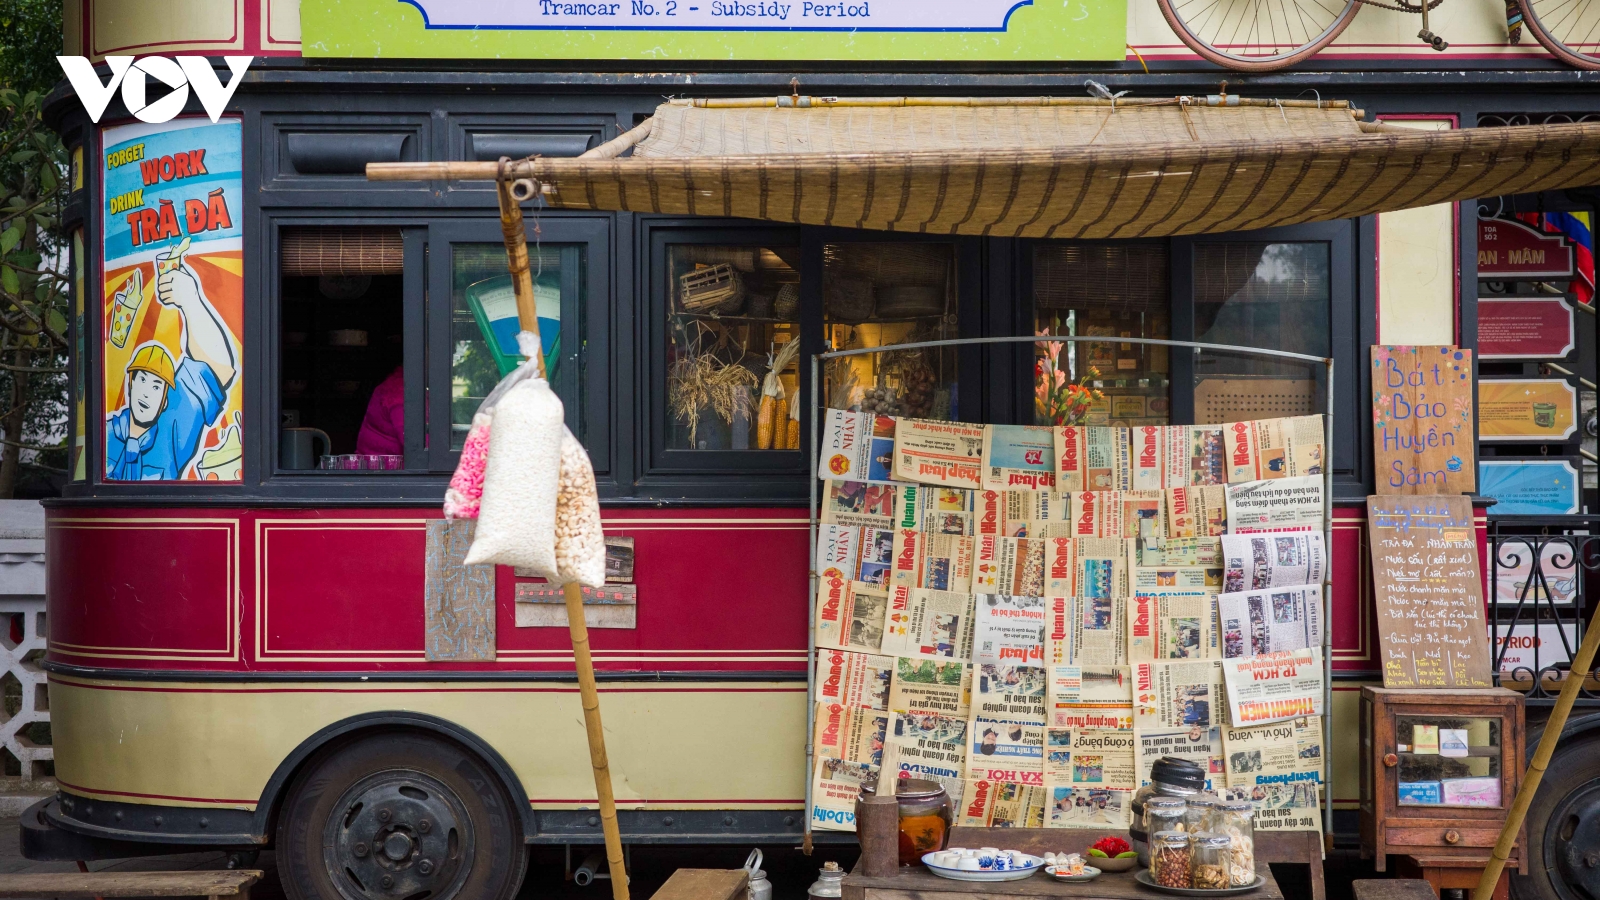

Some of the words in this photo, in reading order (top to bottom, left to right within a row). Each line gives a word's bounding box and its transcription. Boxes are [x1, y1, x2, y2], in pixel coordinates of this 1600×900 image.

[540, 0, 620, 17] Tramcar
[711, 0, 790, 20] Subsidy
[803, 0, 870, 17] Period
[107, 143, 145, 170] FORGET
[140, 148, 208, 187] WORK
[109, 188, 145, 216] DRINK
[127, 198, 182, 247] TRÀ
[185, 187, 233, 235] ĐÁ
[1508, 247, 1545, 265] MÂM
[1387, 357, 1445, 388] Bát
[1392, 393, 1447, 420] Bảo
[841, 417, 856, 451] NHÂN
[1383, 423, 1455, 454] Huyền
[1389, 459, 1447, 487] Sâm
[1104, 736, 1127, 749] công
[1228, 730, 1253, 743] vàng
[1273, 727, 1293, 741] Khổ
